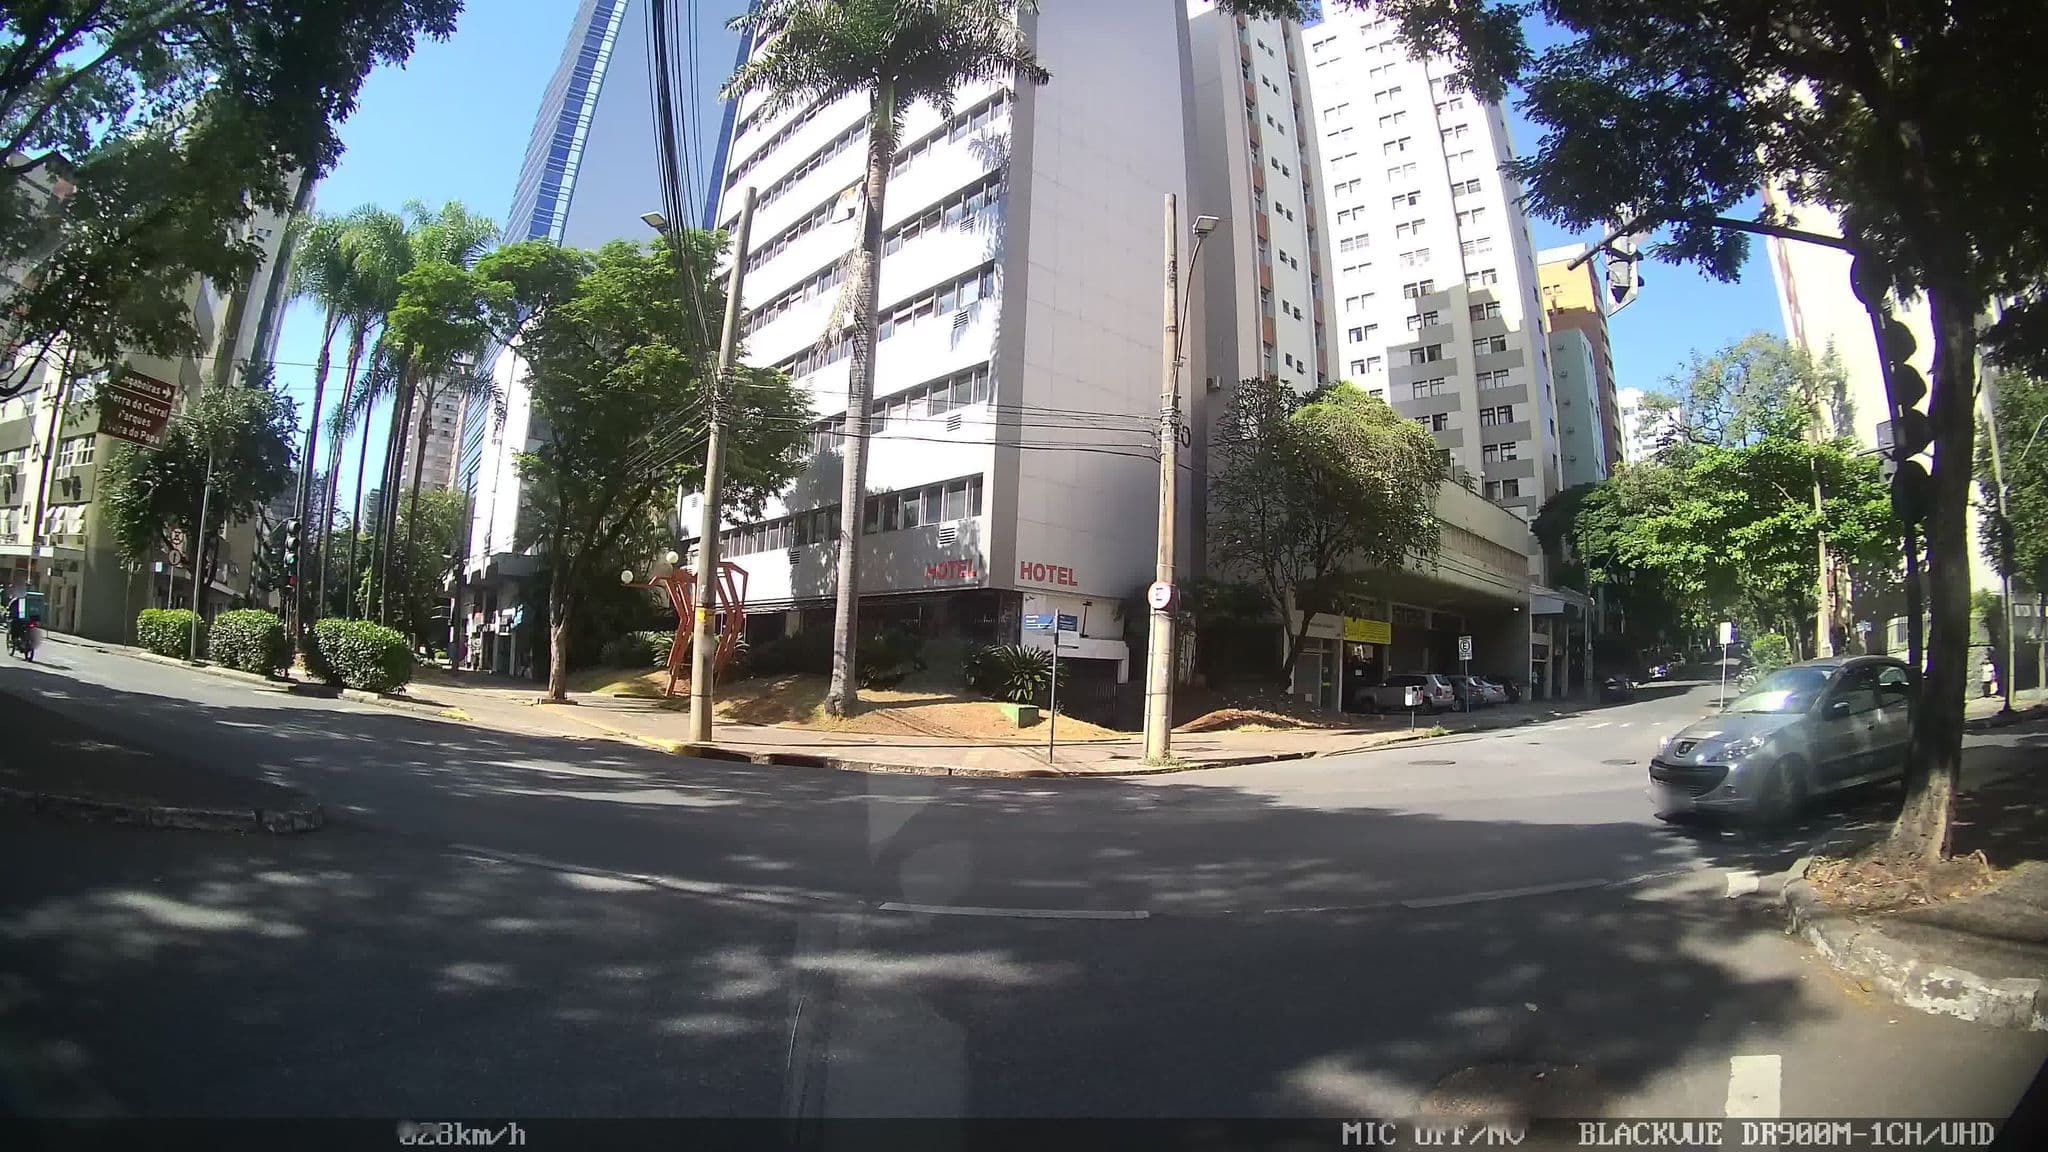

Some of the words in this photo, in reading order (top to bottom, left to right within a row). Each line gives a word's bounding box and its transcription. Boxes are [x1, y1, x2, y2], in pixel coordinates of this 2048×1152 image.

[143, 402, 169, 419] Curral
[925, 559, 977, 580] HOTEL
[1020, 561, 1078, 587] HOTEL
